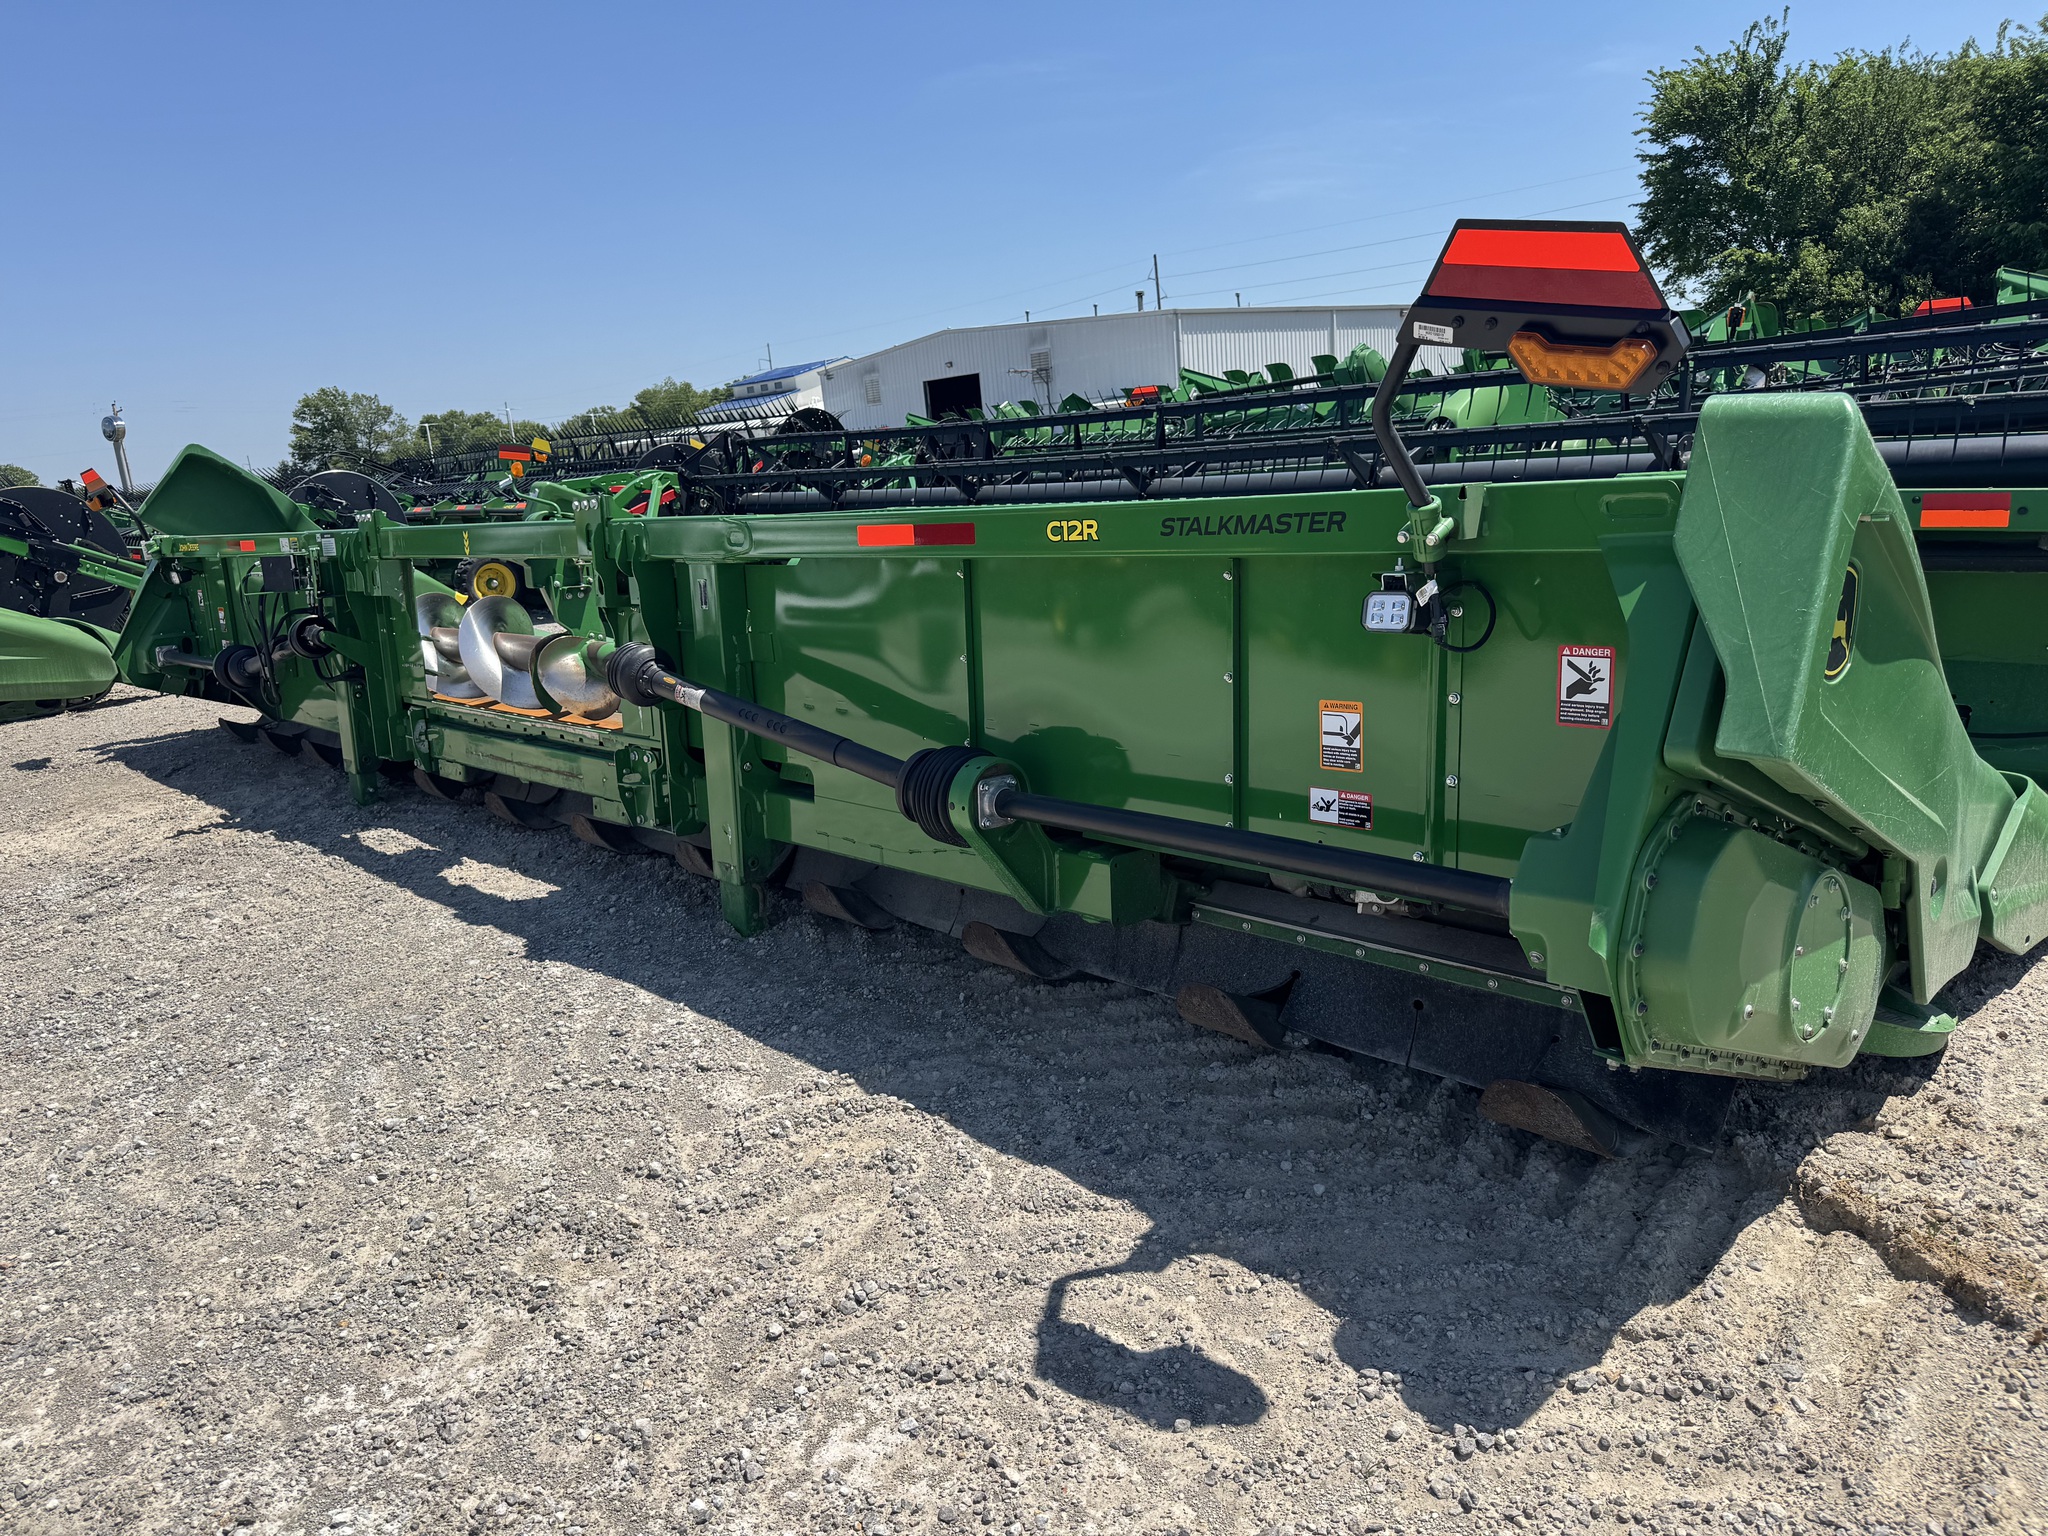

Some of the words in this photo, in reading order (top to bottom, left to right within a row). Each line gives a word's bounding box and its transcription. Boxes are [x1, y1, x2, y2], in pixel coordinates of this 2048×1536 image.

[1046, 519, 1100, 542] C12R
[1159, 511, 1347, 537] STALKMASTER
[1572, 648, 1610, 656] DANGER
[1330, 703, 1358, 711] WARNING
